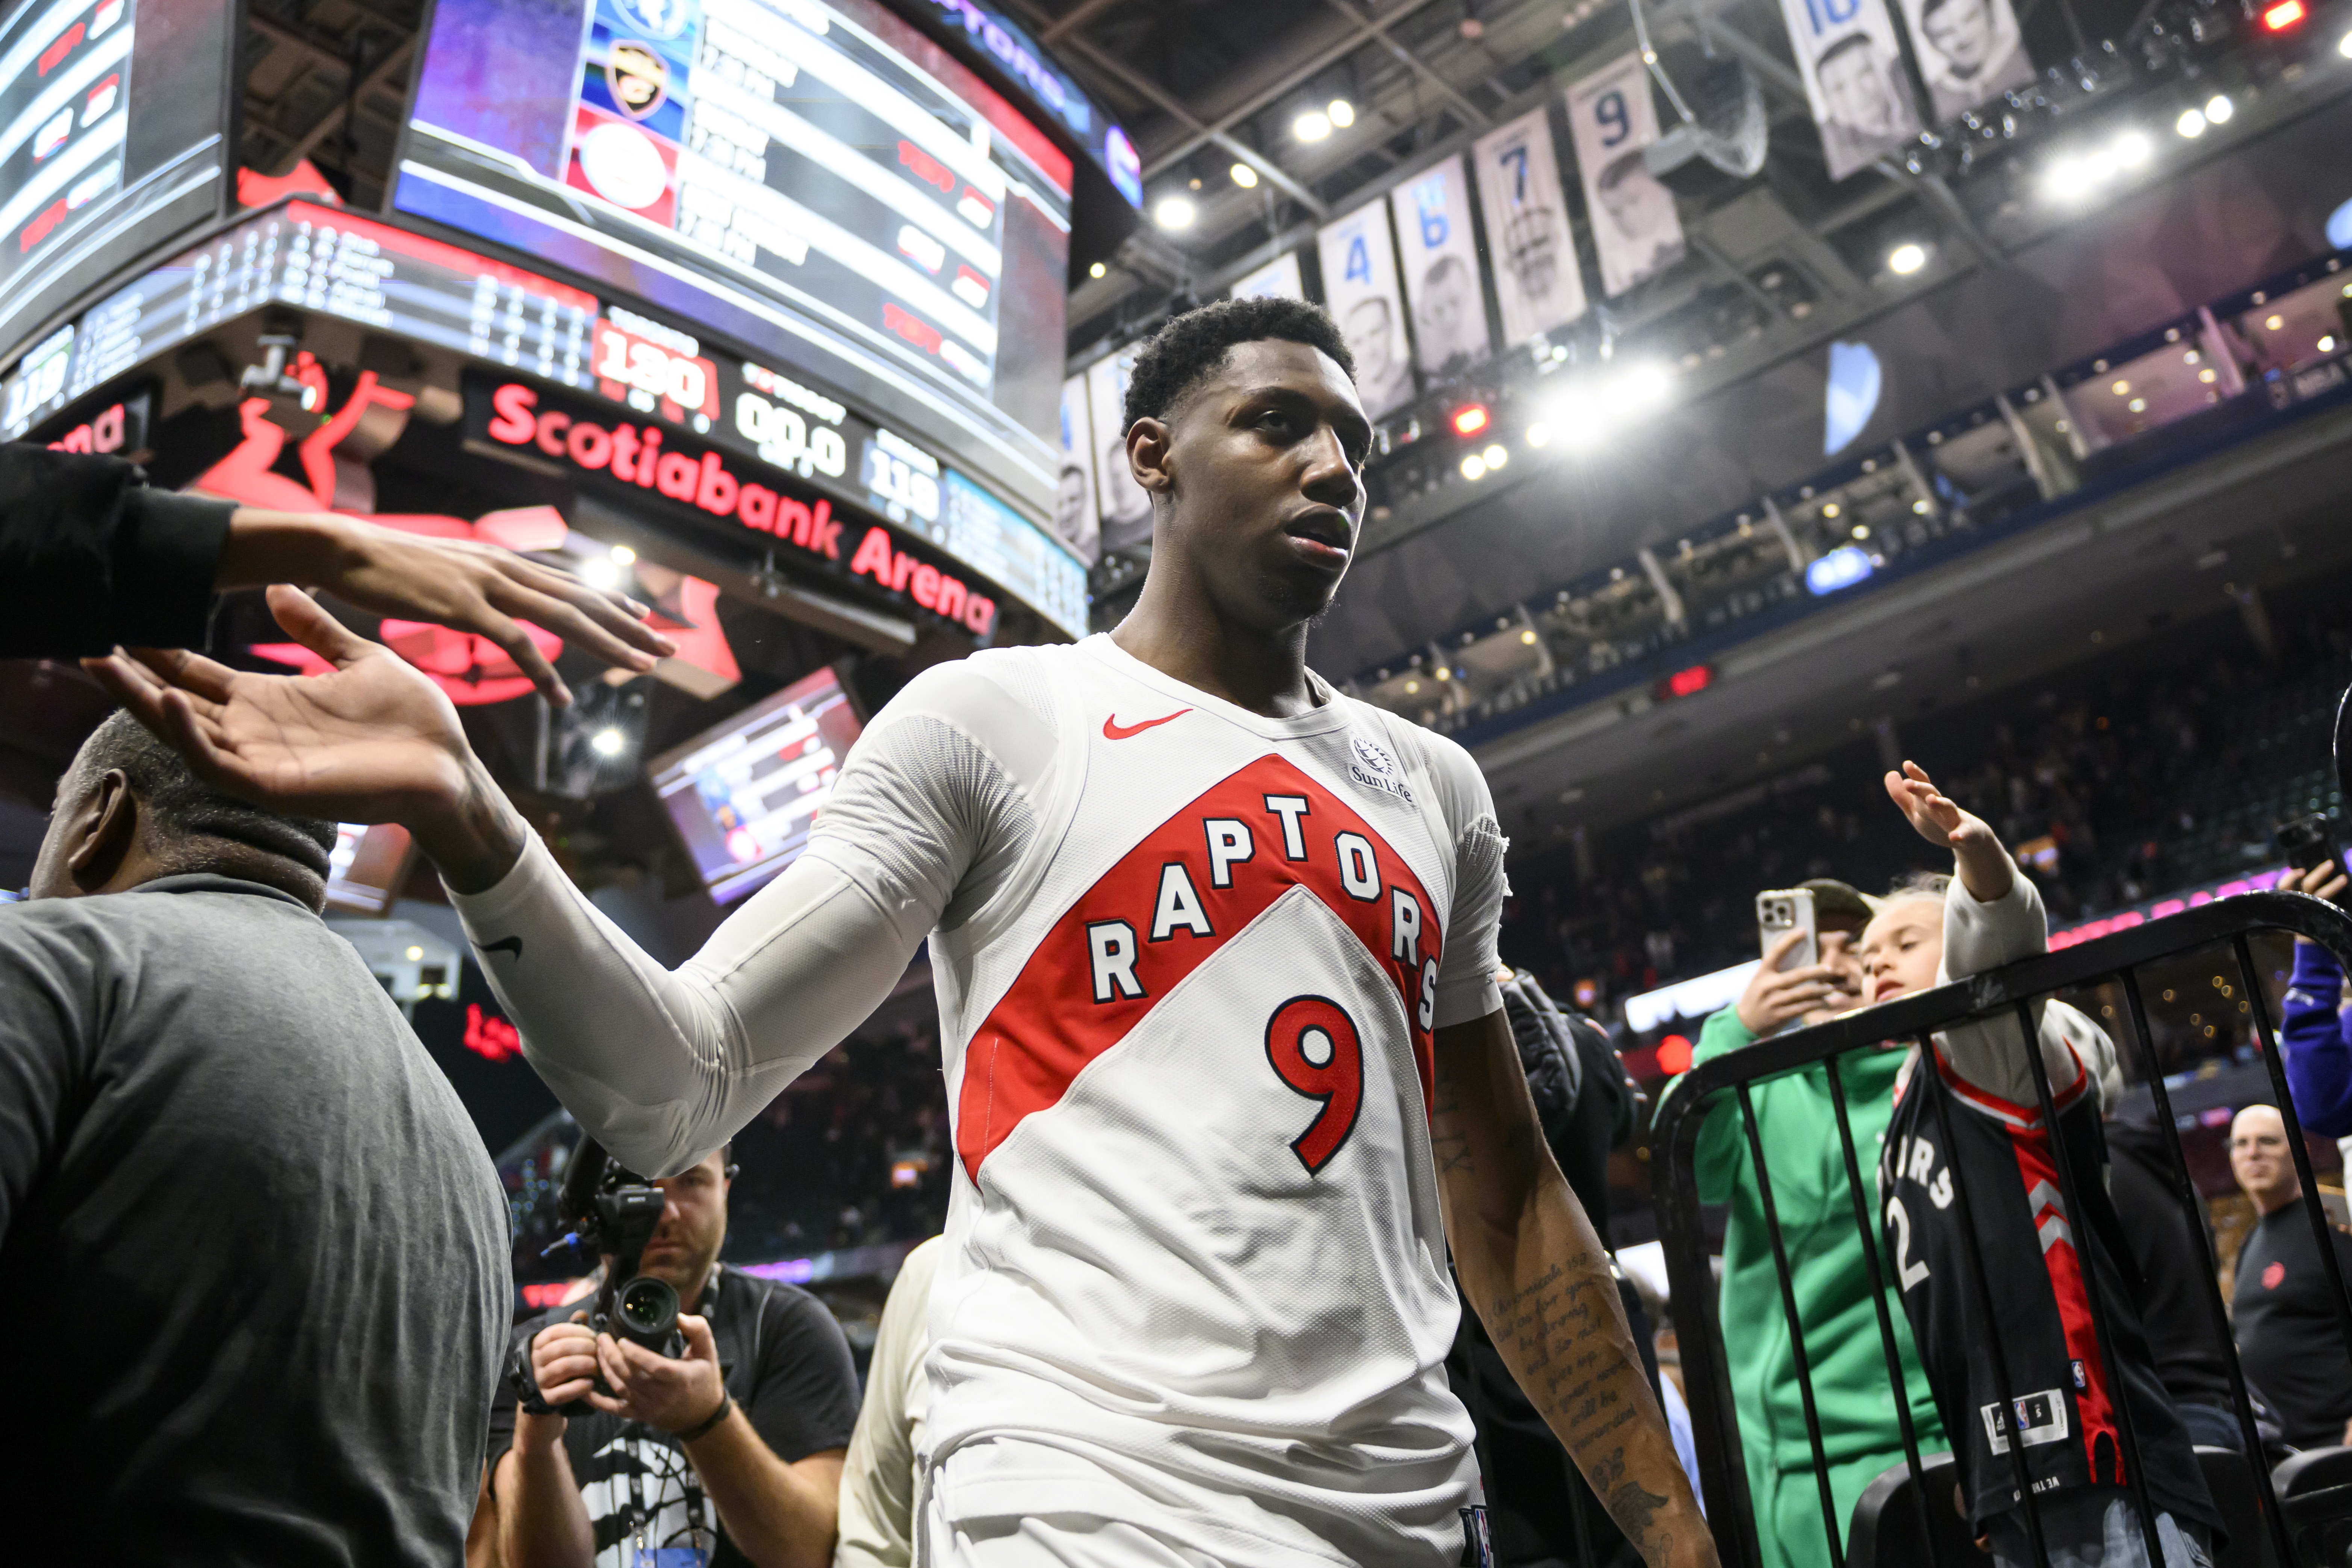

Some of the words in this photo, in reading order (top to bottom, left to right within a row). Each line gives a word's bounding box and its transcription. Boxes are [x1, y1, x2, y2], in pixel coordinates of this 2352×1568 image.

[941, 0, 1066, 111] TORS
[1594, 89, 1632, 148] 9
[1500, 144, 1528, 203] 7
[1345, 235, 1373, 285] 4
[47, 403, 126, 454] na
[488, 384, 844, 559] Scotiabank
[851, 526, 995, 636] Arena
[1352, 766, 1384, 788] Sun
[1383, 777, 1412, 802] Life
[1086, 793, 1437, 1035] RAPTORS
[1264, 994, 1365, 1178] 9
[1886, 1196, 1931, 1293] 2
